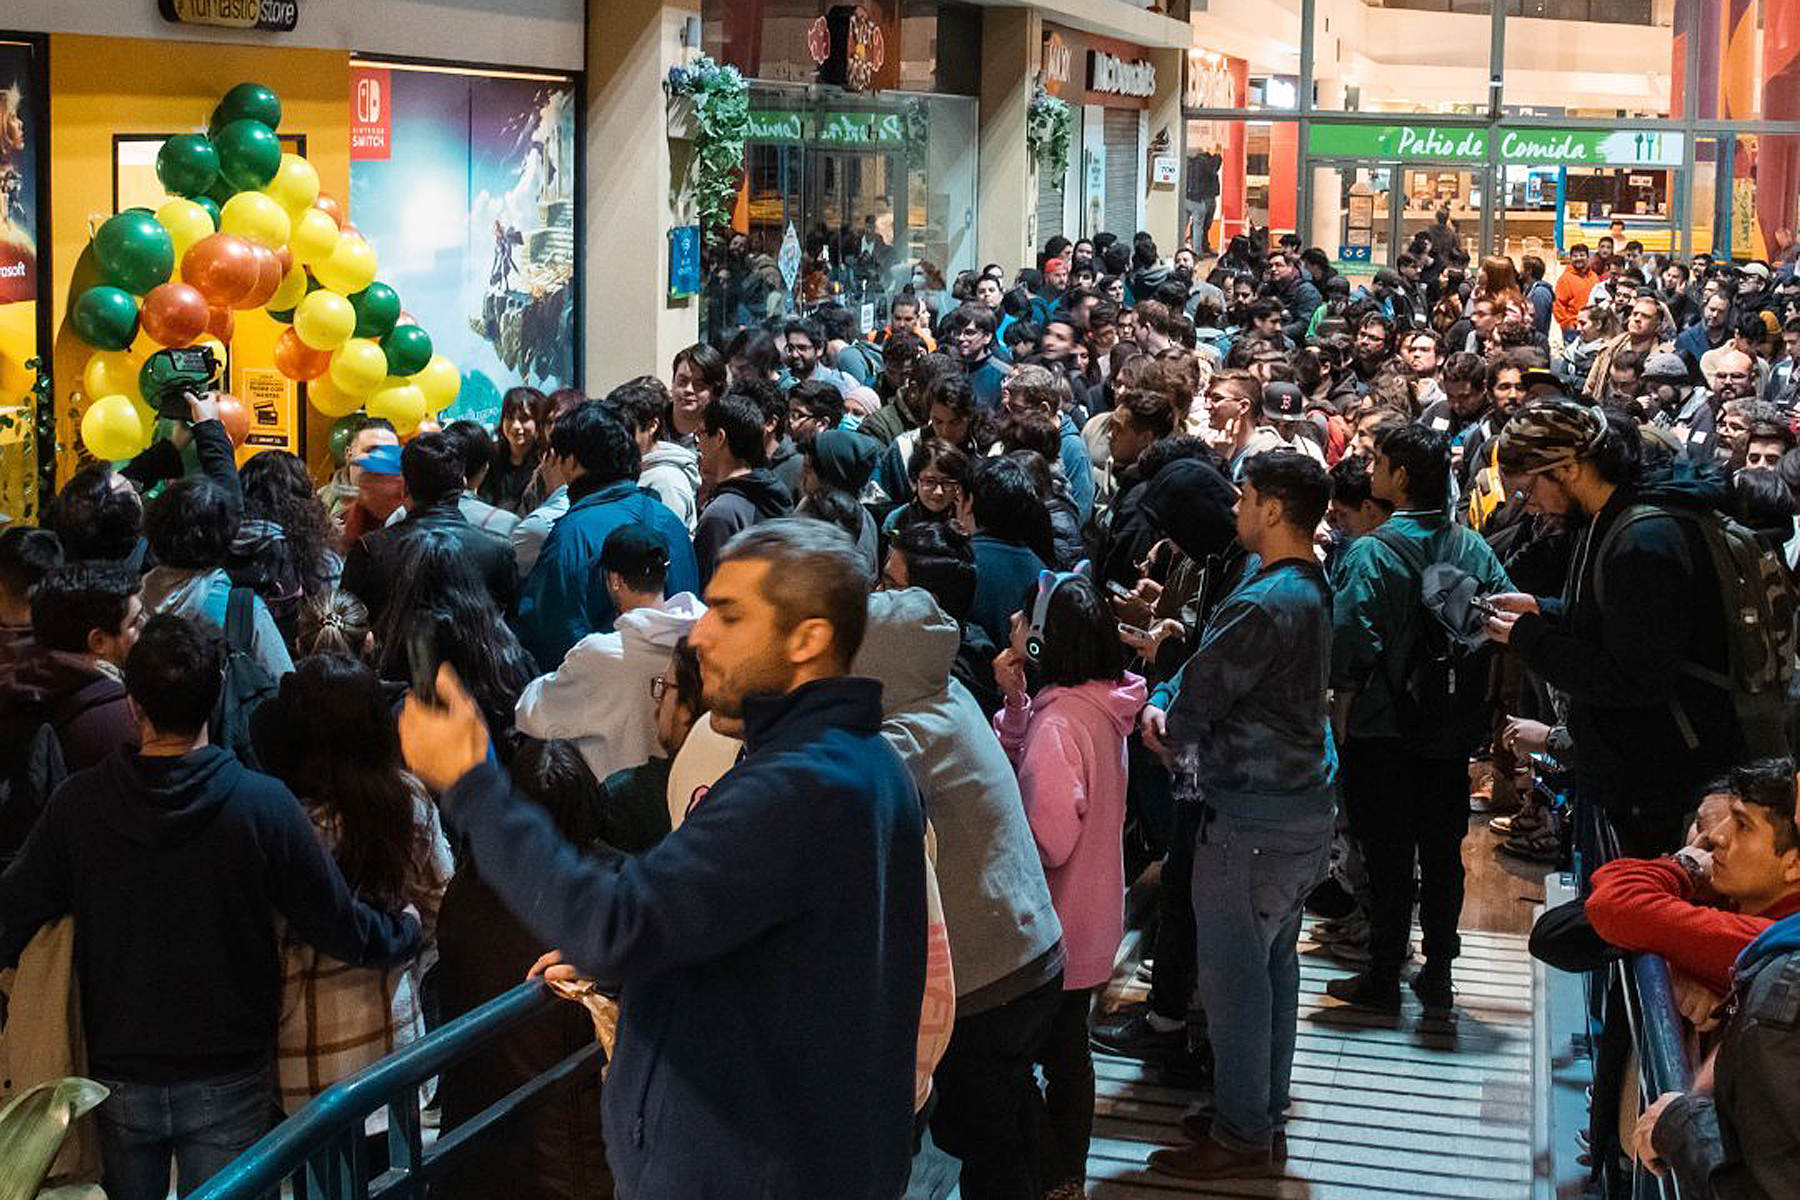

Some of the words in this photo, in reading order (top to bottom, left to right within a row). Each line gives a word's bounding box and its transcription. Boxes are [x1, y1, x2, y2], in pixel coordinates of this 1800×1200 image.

[260, 1, 295, 24] store
[353, 135, 384, 148] SWITCH
[1397, 126, 1454, 157] Patio
[1456, 131, 1483, 157] de
[1501, 130, 1587, 160] Comida
